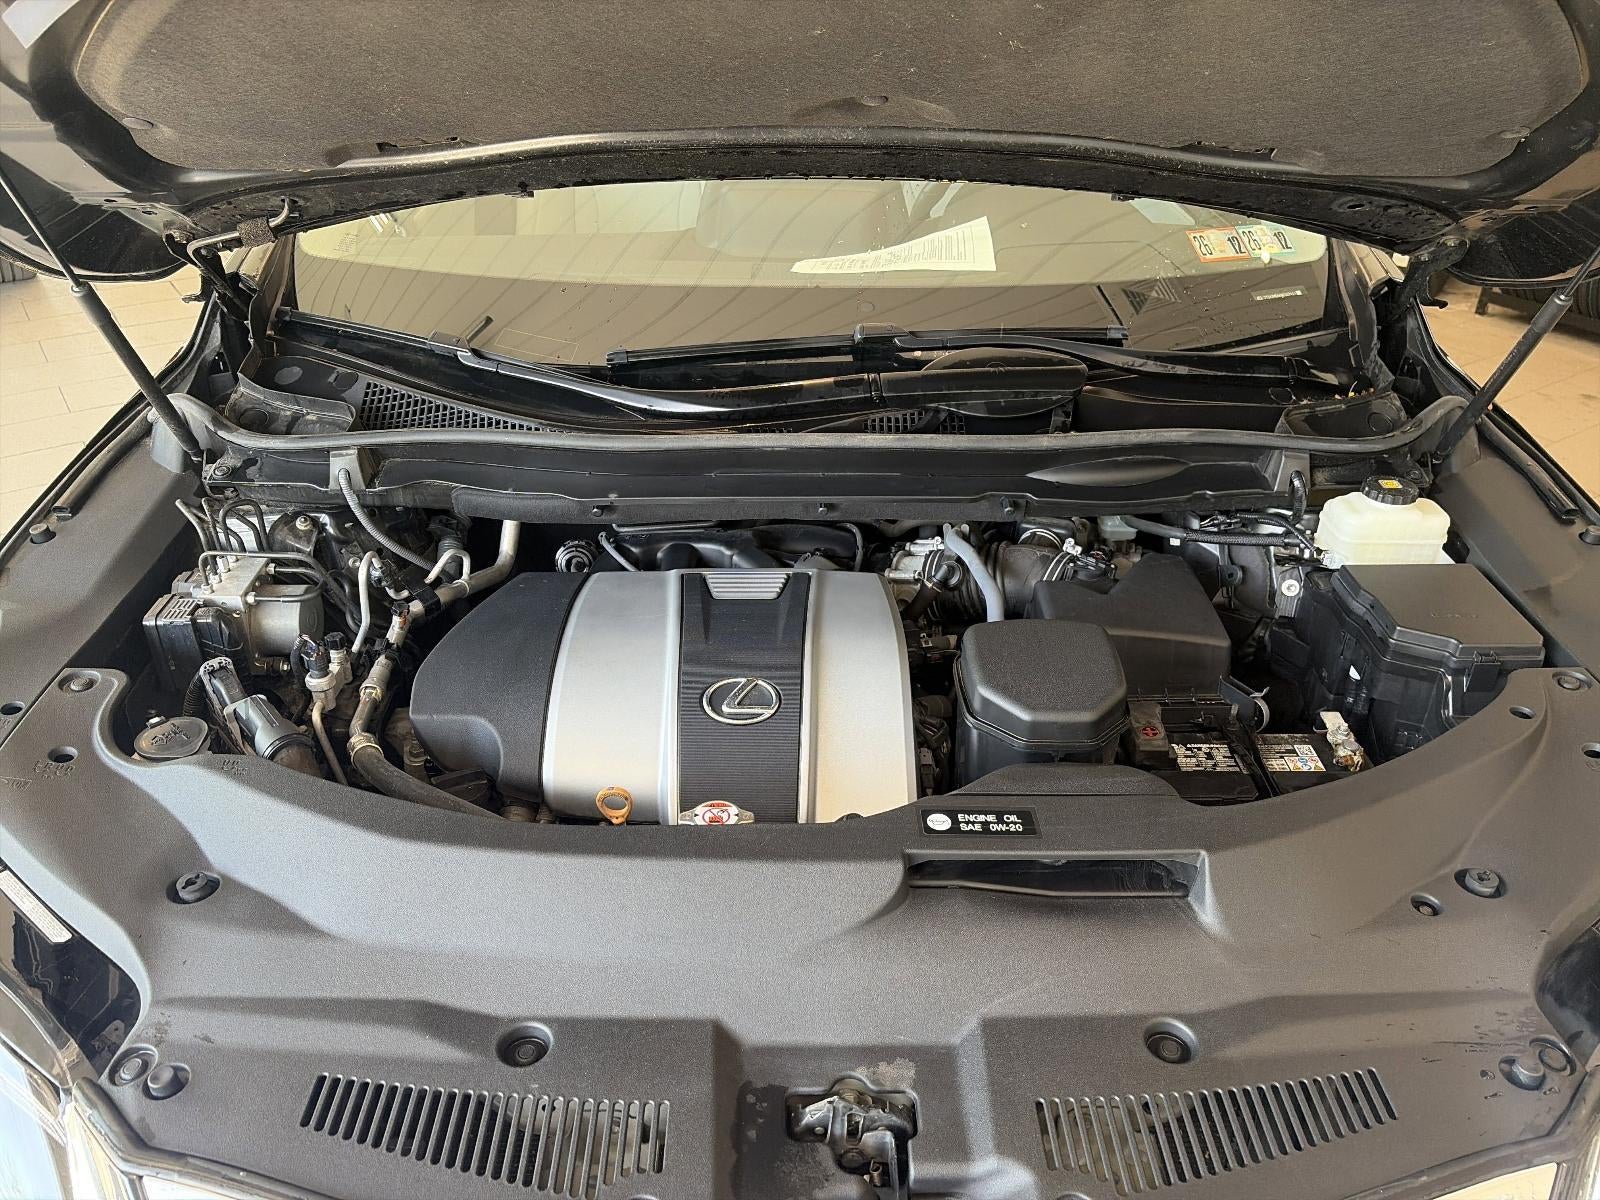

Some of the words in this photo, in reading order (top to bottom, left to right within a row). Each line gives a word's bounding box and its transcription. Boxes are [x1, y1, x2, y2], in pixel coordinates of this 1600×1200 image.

[1193, 235, 1213, 256] 26
[1227, 236, 1246, 254] 12
[1241, 230, 1262, 251] 26
[1273, 231, 1292, 250] 12
[957, 813, 998, 822] ENGINE
[1003, 814, 1022, 822] OIL
[960, 823, 983, 831] SAE
[989, 823, 1023, 831] 0W-20
